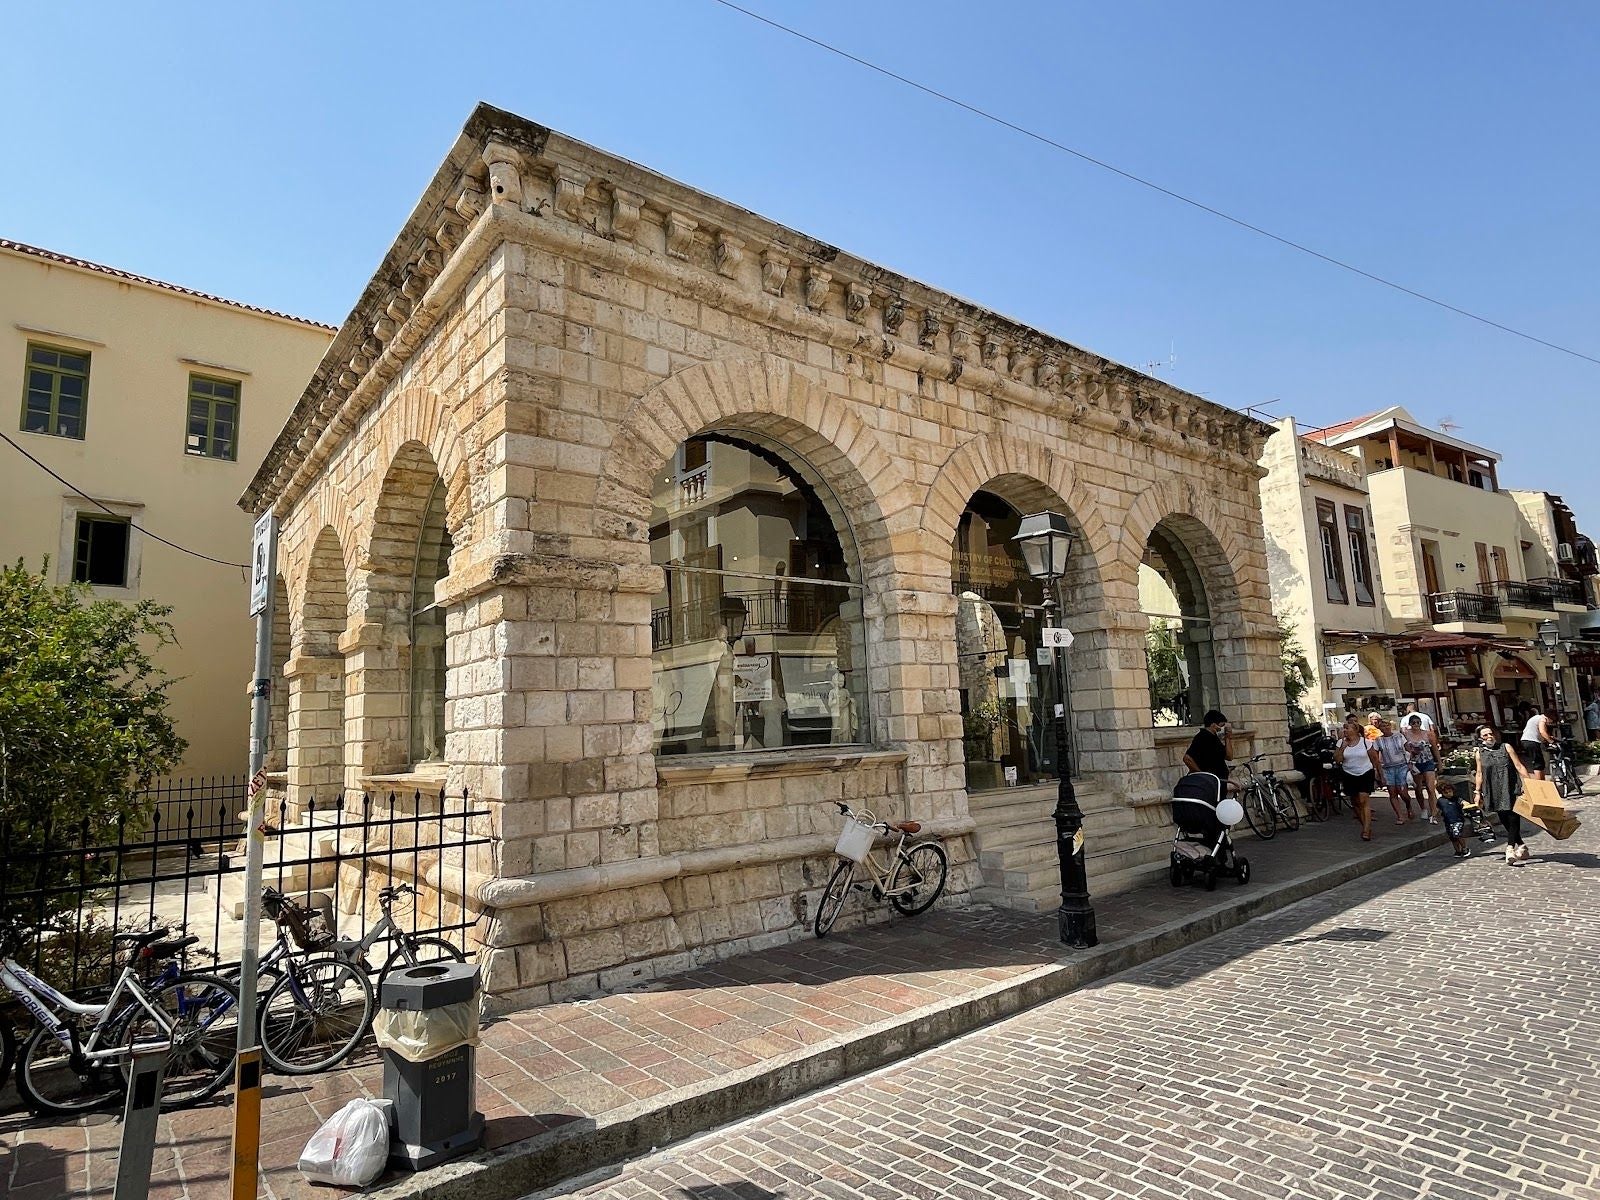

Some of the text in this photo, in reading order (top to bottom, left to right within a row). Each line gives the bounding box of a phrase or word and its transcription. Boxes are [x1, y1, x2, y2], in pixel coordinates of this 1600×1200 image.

[953, 551, 1026, 569] INISTRY OF CULTURE
[435, 1072, 457, 1084] 2017
